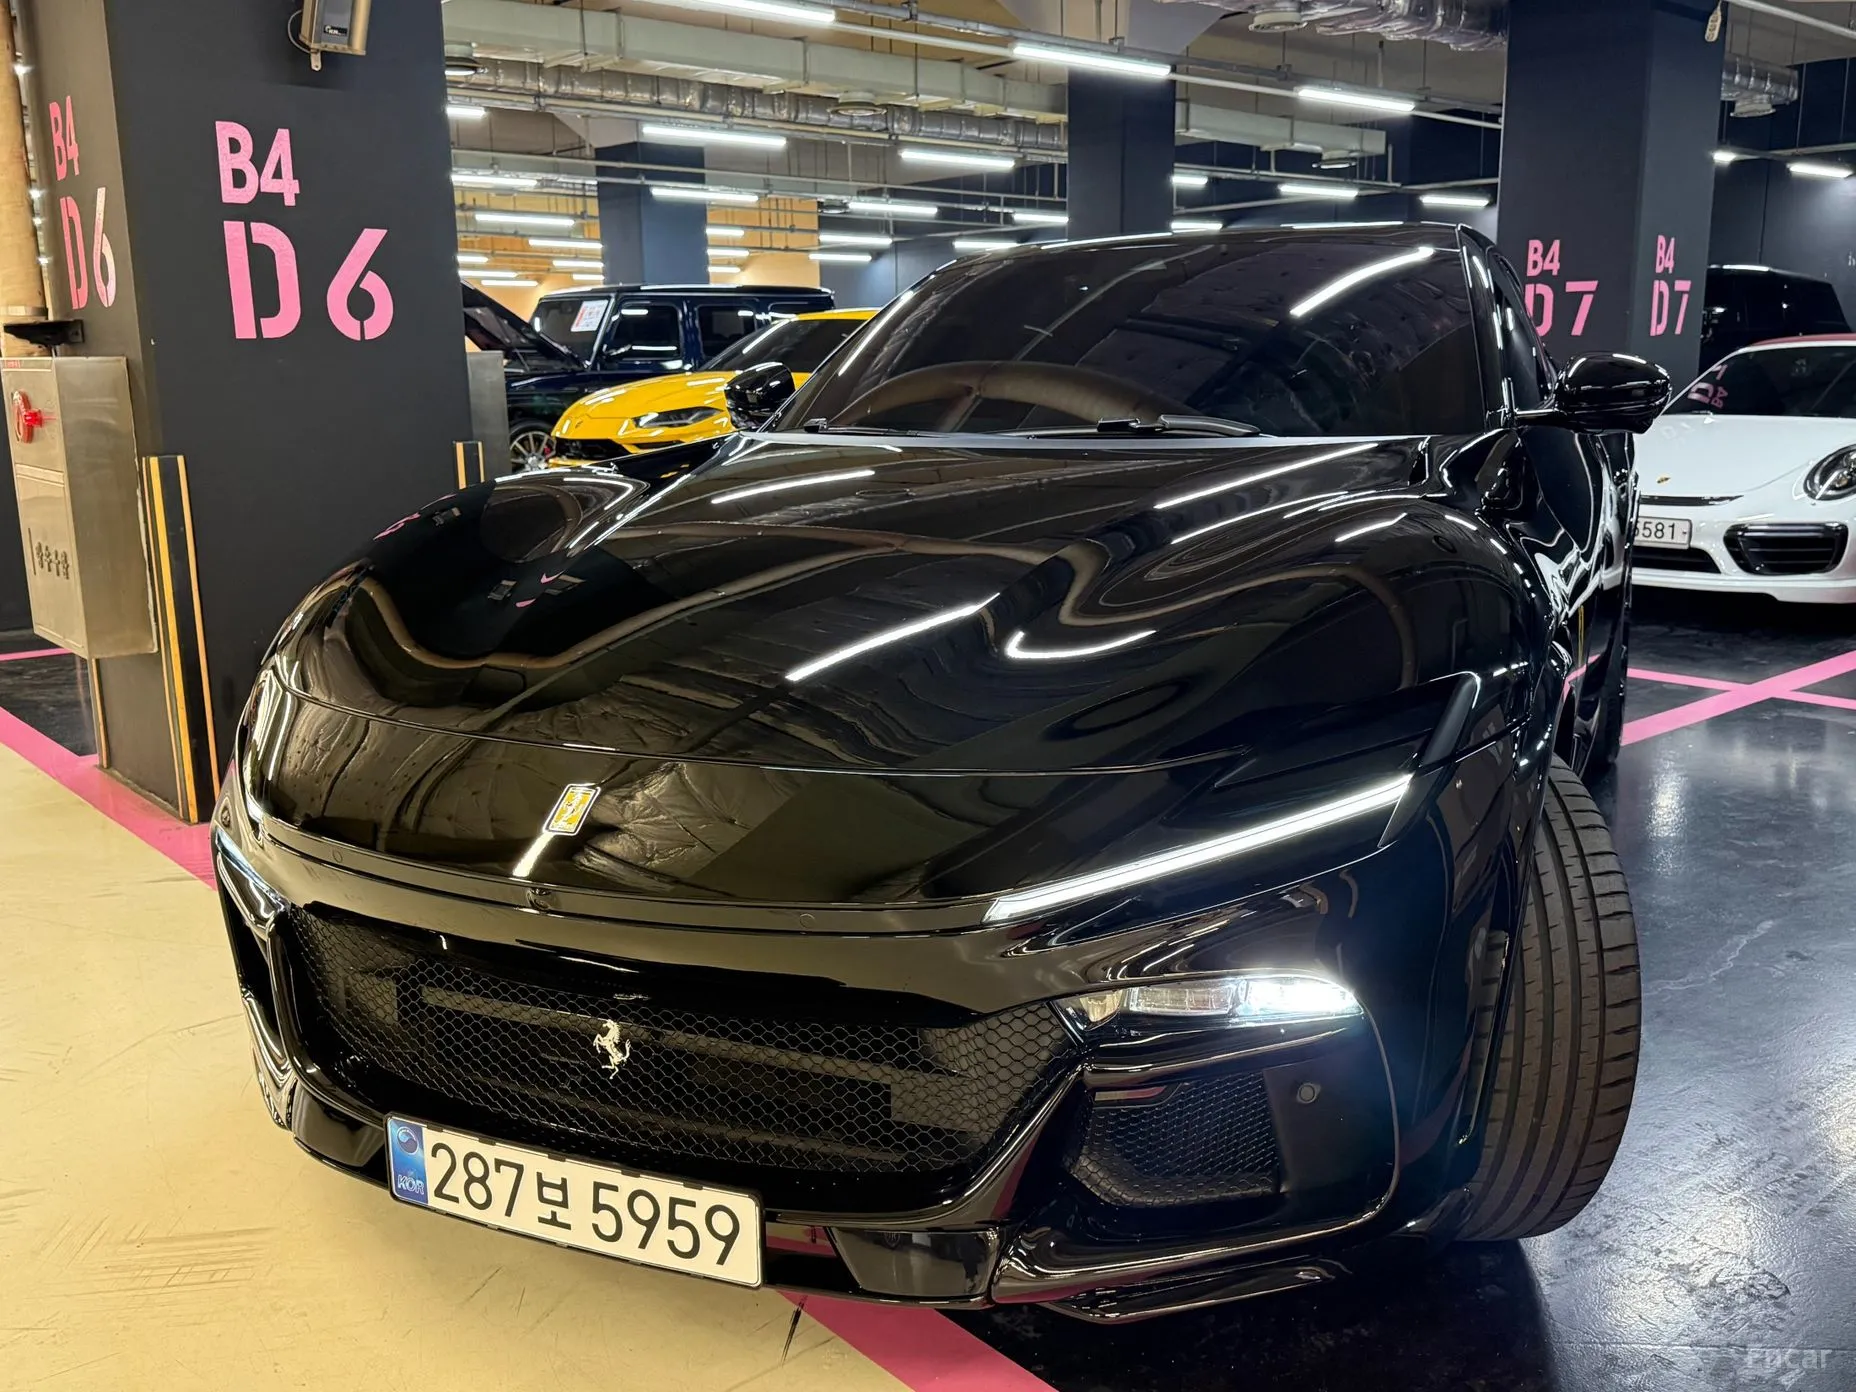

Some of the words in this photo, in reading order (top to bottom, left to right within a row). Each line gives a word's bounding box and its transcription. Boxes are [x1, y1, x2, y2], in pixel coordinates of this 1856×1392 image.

[49, 96, 80, 181] B4
[215, 120, 301, 207] B4
[1526, 239, 1561, 277] B4
[1655, 234, 1676, 275] B4
[397, 1174, 425, 1195] KOR
[431, 1142, 572, 1231] 287보
[591, 1181, 741, 1266] 5959
